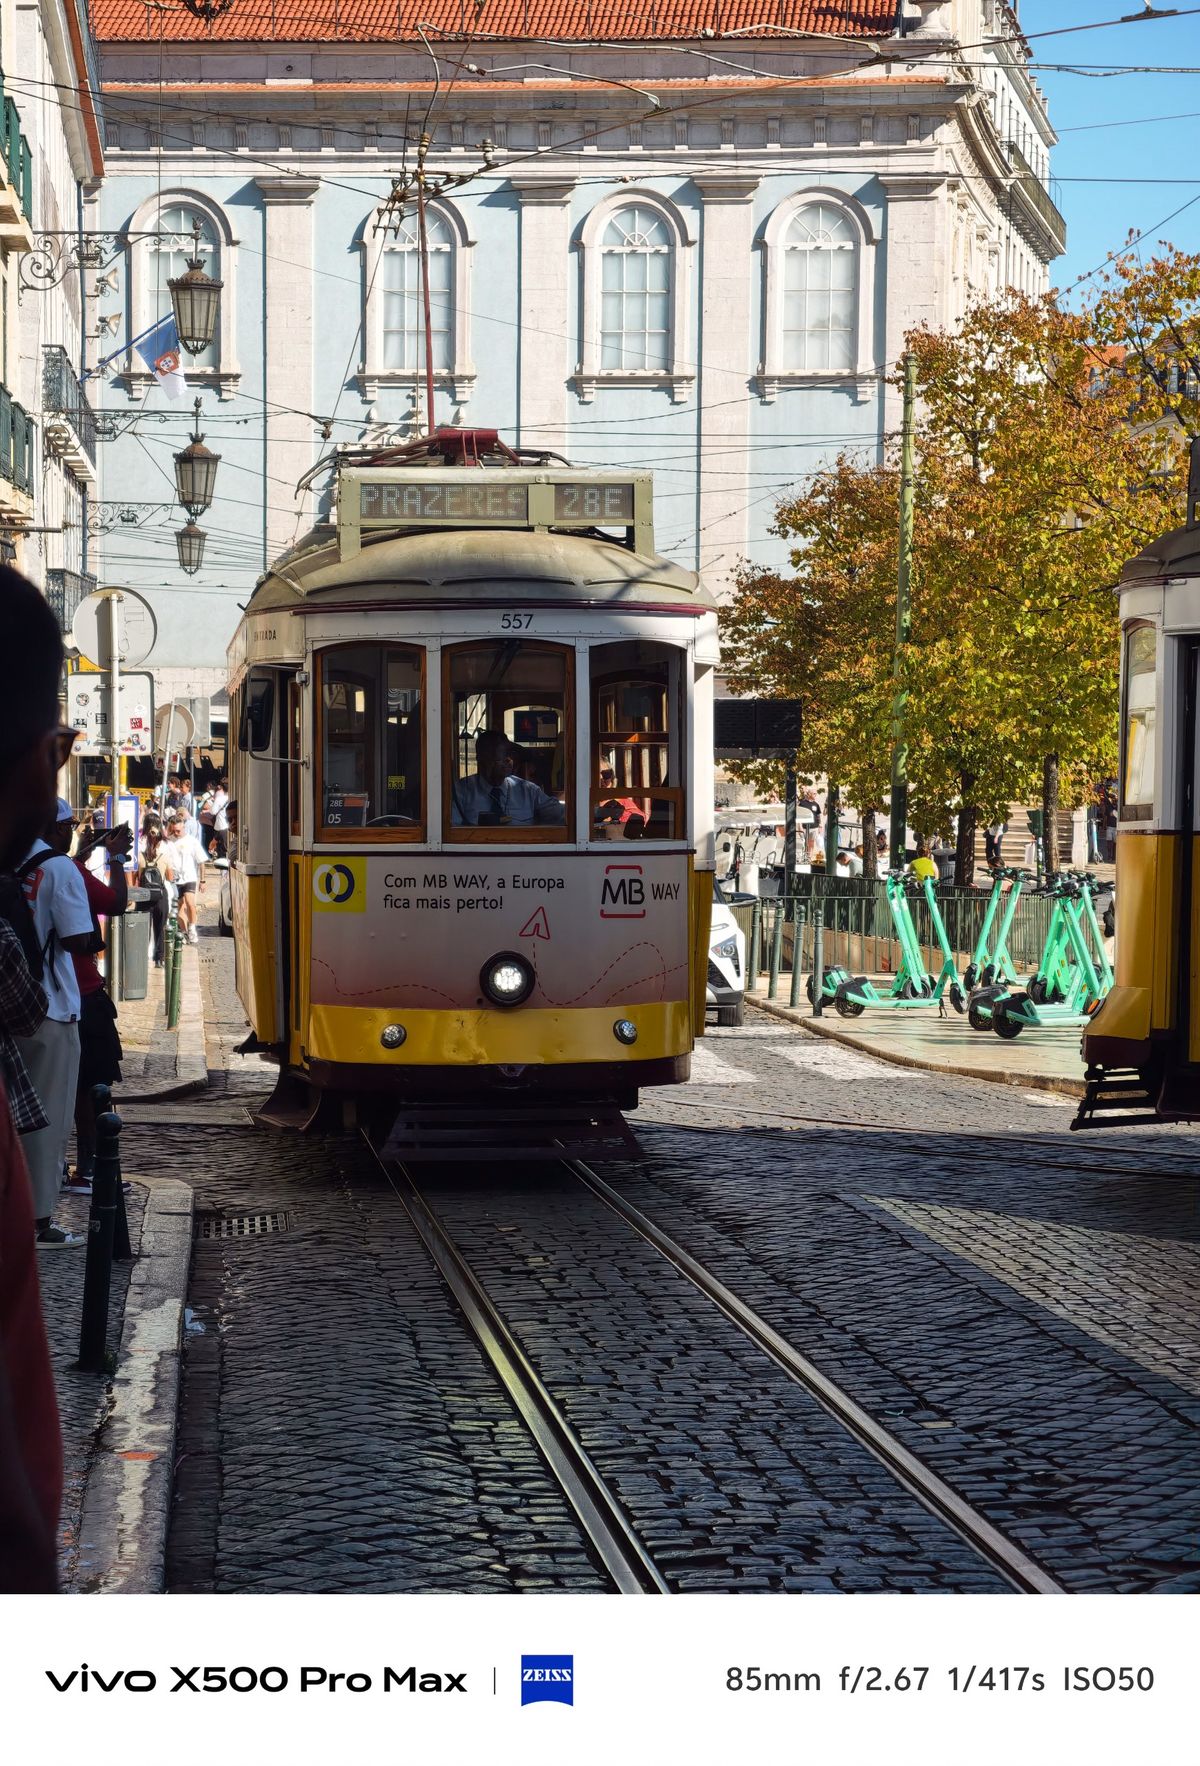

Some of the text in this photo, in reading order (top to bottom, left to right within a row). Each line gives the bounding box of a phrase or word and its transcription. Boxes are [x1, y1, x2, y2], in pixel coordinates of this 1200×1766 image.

[563, 488, 623, 517] 28E
[501, 613, 534, 629] 557
[329, 799, 343, 807] 28E
[327, 813, 342, 824] 05
[384, 874, 565, 893] Com MB WAY, a Europa
[601, 878, 680, 905] MB WAY
[383, 894, 503, 913] fica mais perto!
